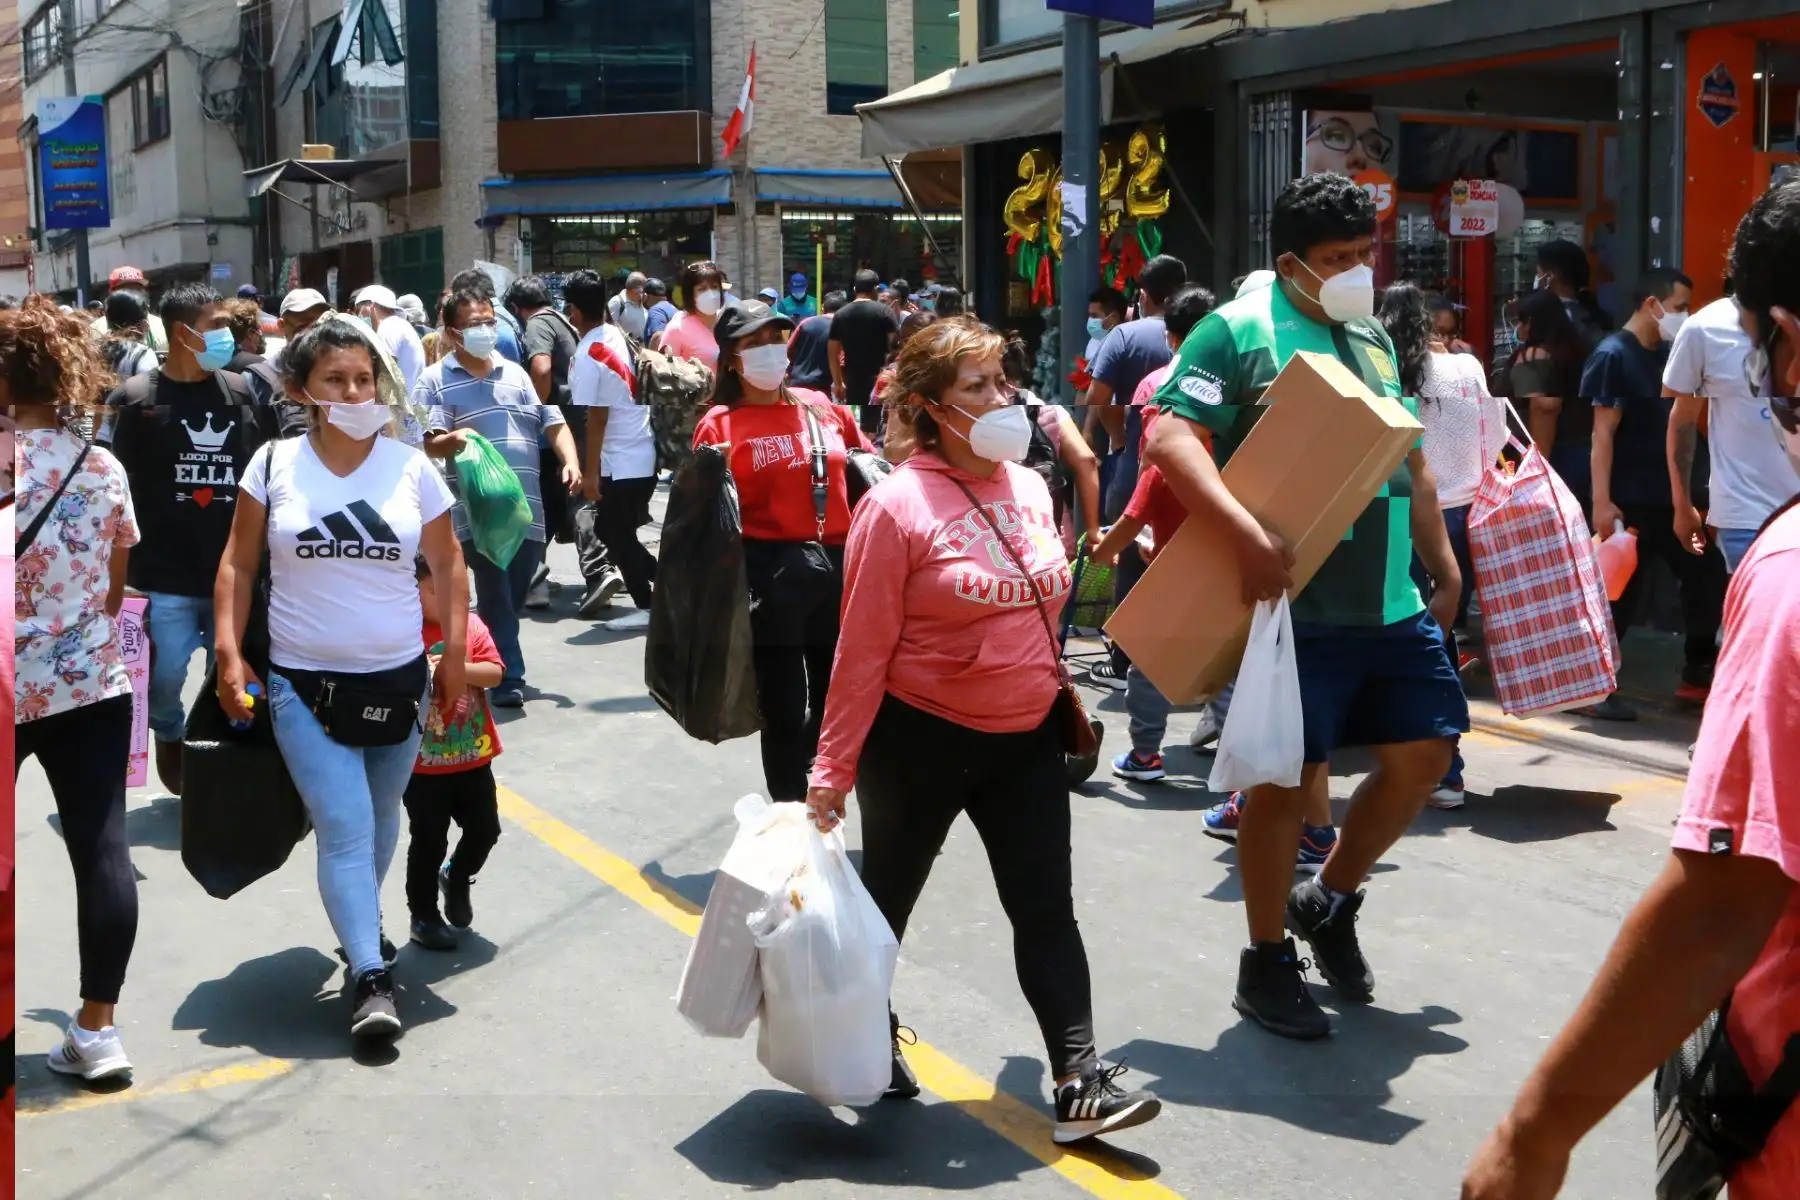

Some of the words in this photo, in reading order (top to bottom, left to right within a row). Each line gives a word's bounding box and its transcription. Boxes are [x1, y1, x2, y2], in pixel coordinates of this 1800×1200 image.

[1460, 217, 1485, 231] 2022
[1185, 379, 1217, 400] Arica
[179, 453, 208, 461] LOCO
[212, 454, 233, 463] POR
[746, 435, 795, 472] NEW
[174, 464, 236, 486] ELLA
[295, 538, 402, 561] adidas
[121, 617, 138, 656] Funny
[362, 706, 392, 722] CAT
